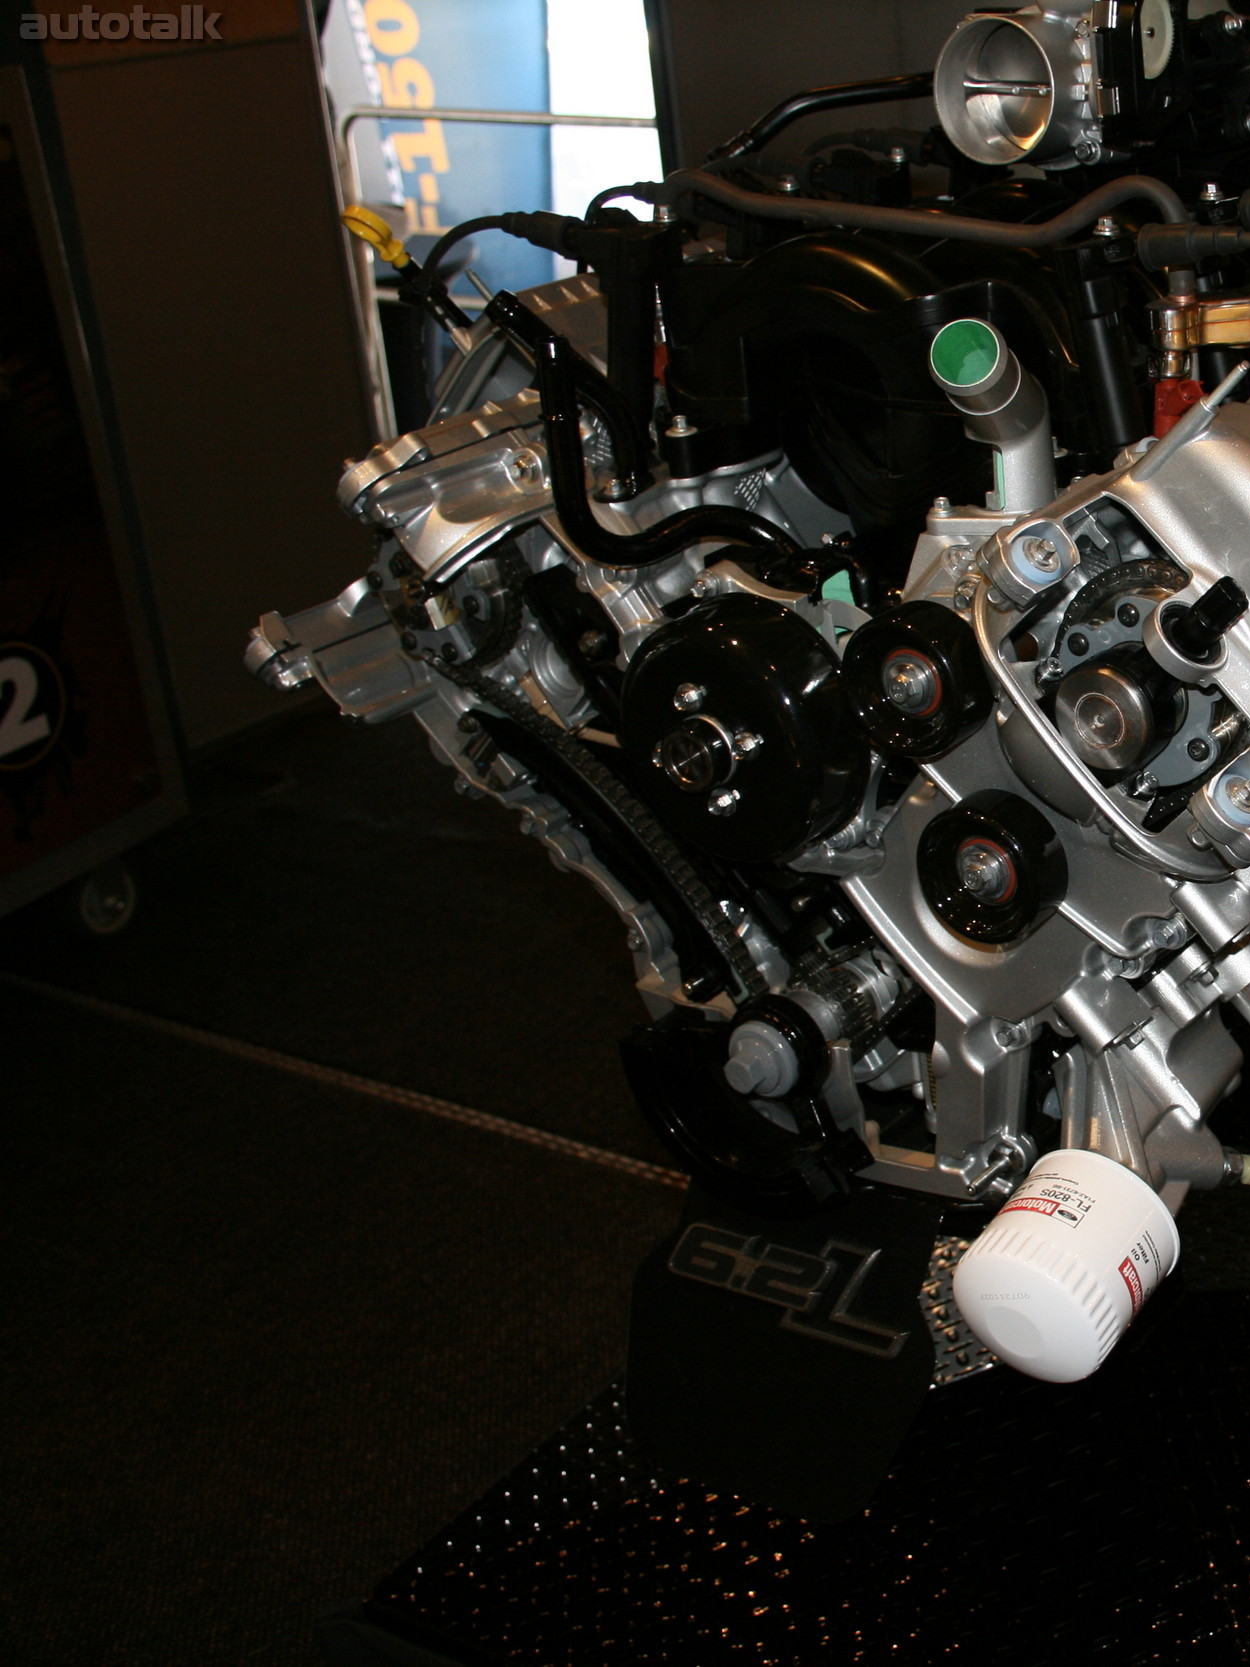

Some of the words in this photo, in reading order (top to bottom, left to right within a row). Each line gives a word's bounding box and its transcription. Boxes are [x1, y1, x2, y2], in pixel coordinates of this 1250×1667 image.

[0, 656, 52, 759] 2
[1040, 1189, 1092, 1213] FL-820S
[1131, 1248, 1141, 1261] Oil
[1136, 1242, 1150, 1264] Filter
